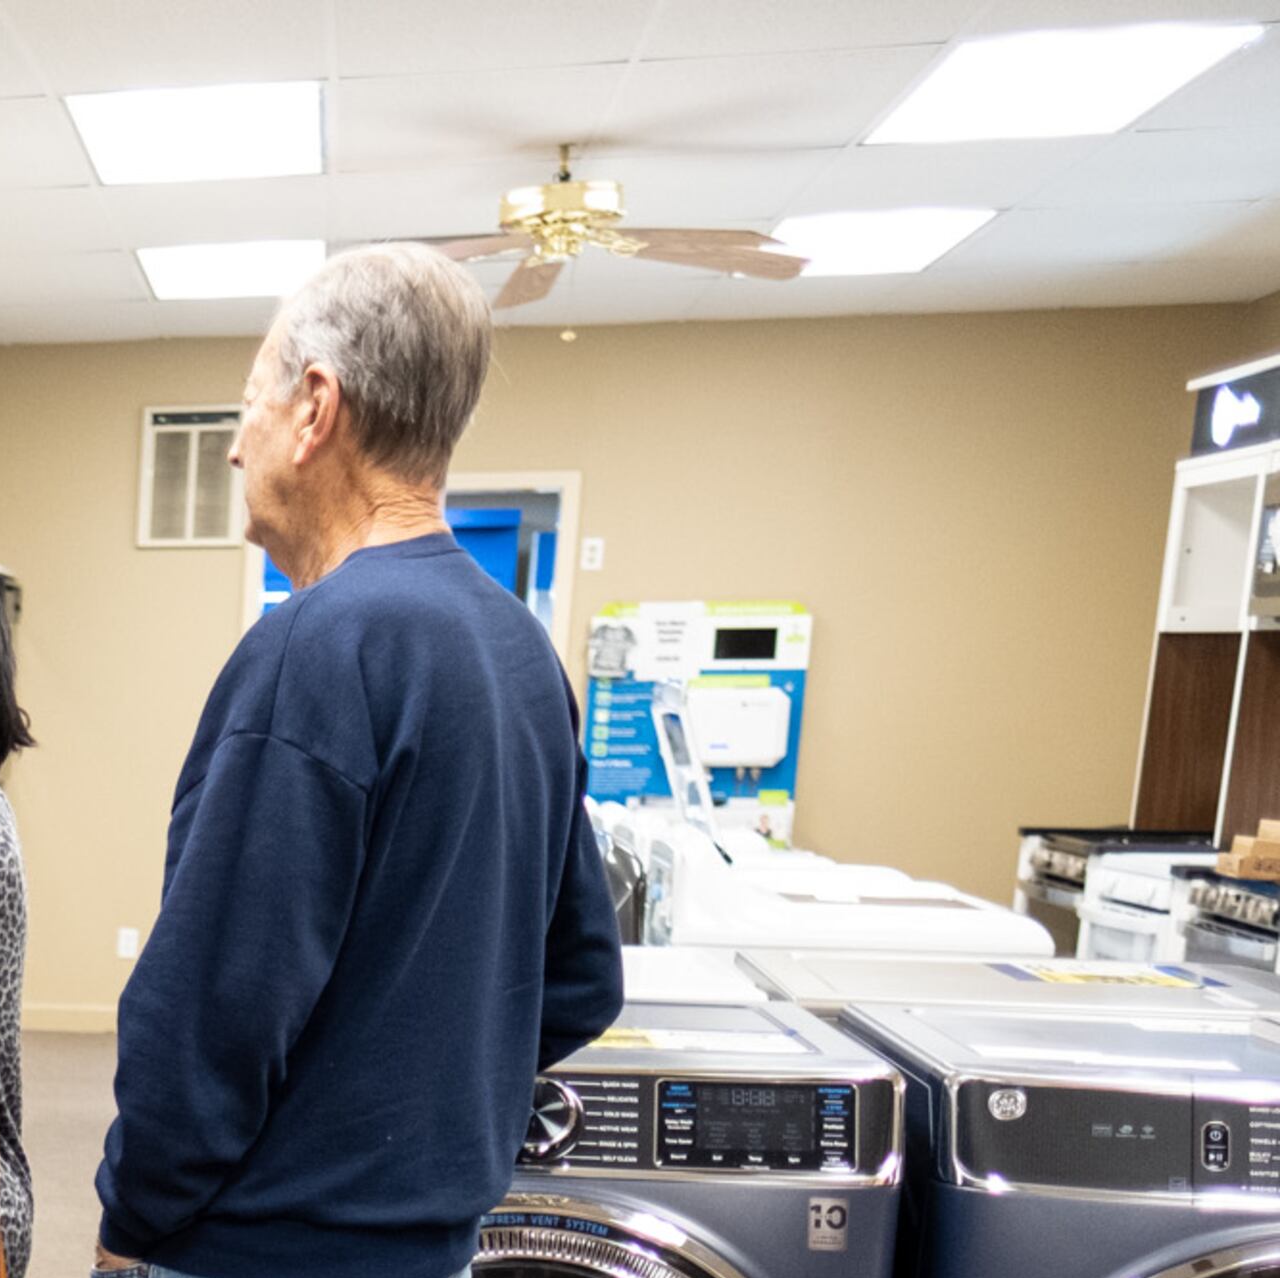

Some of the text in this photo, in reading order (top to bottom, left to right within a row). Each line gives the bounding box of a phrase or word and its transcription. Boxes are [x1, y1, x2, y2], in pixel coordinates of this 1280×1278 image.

[530, 1215, 561, 1226] VENT
[565, 1218, 609, 1235] SYSTEM
[810, 1203, 847, 1230] 10
